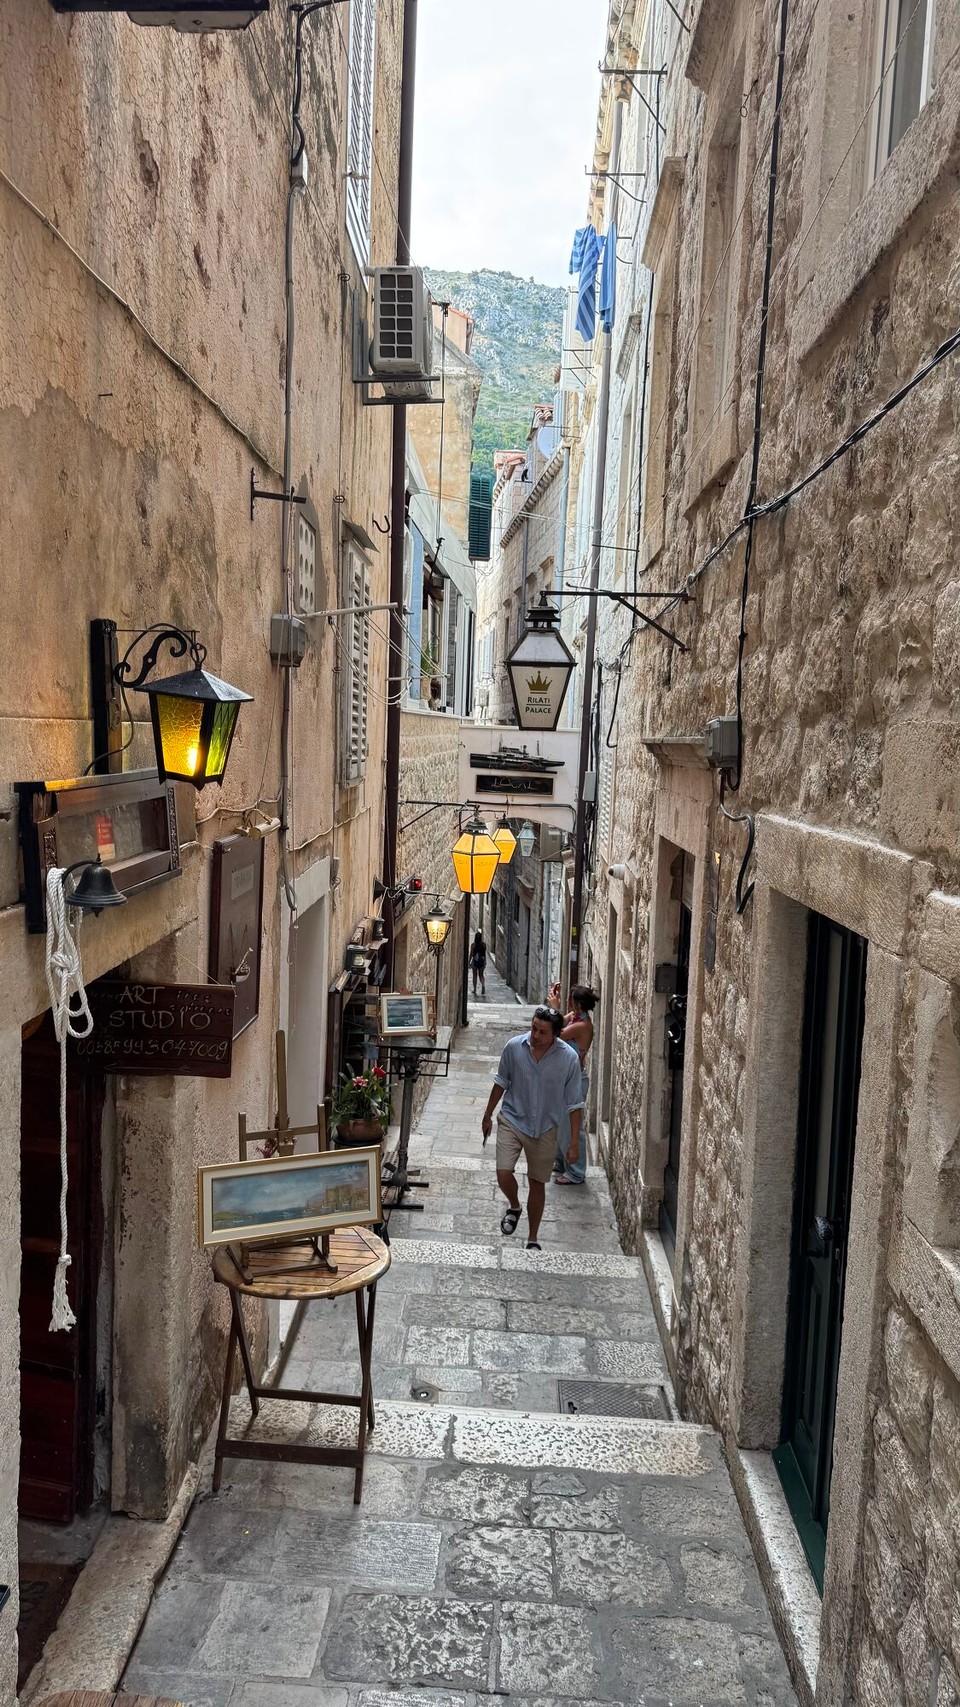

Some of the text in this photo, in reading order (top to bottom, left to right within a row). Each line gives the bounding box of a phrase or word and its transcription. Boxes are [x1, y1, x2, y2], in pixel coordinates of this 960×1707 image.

[527, 696, 551, 704] RILATI
[525, 706, 552, 714] PALACE
[119, 985, 166, 1005] ART
[109, 1010, 211, 1030] STUDIO
